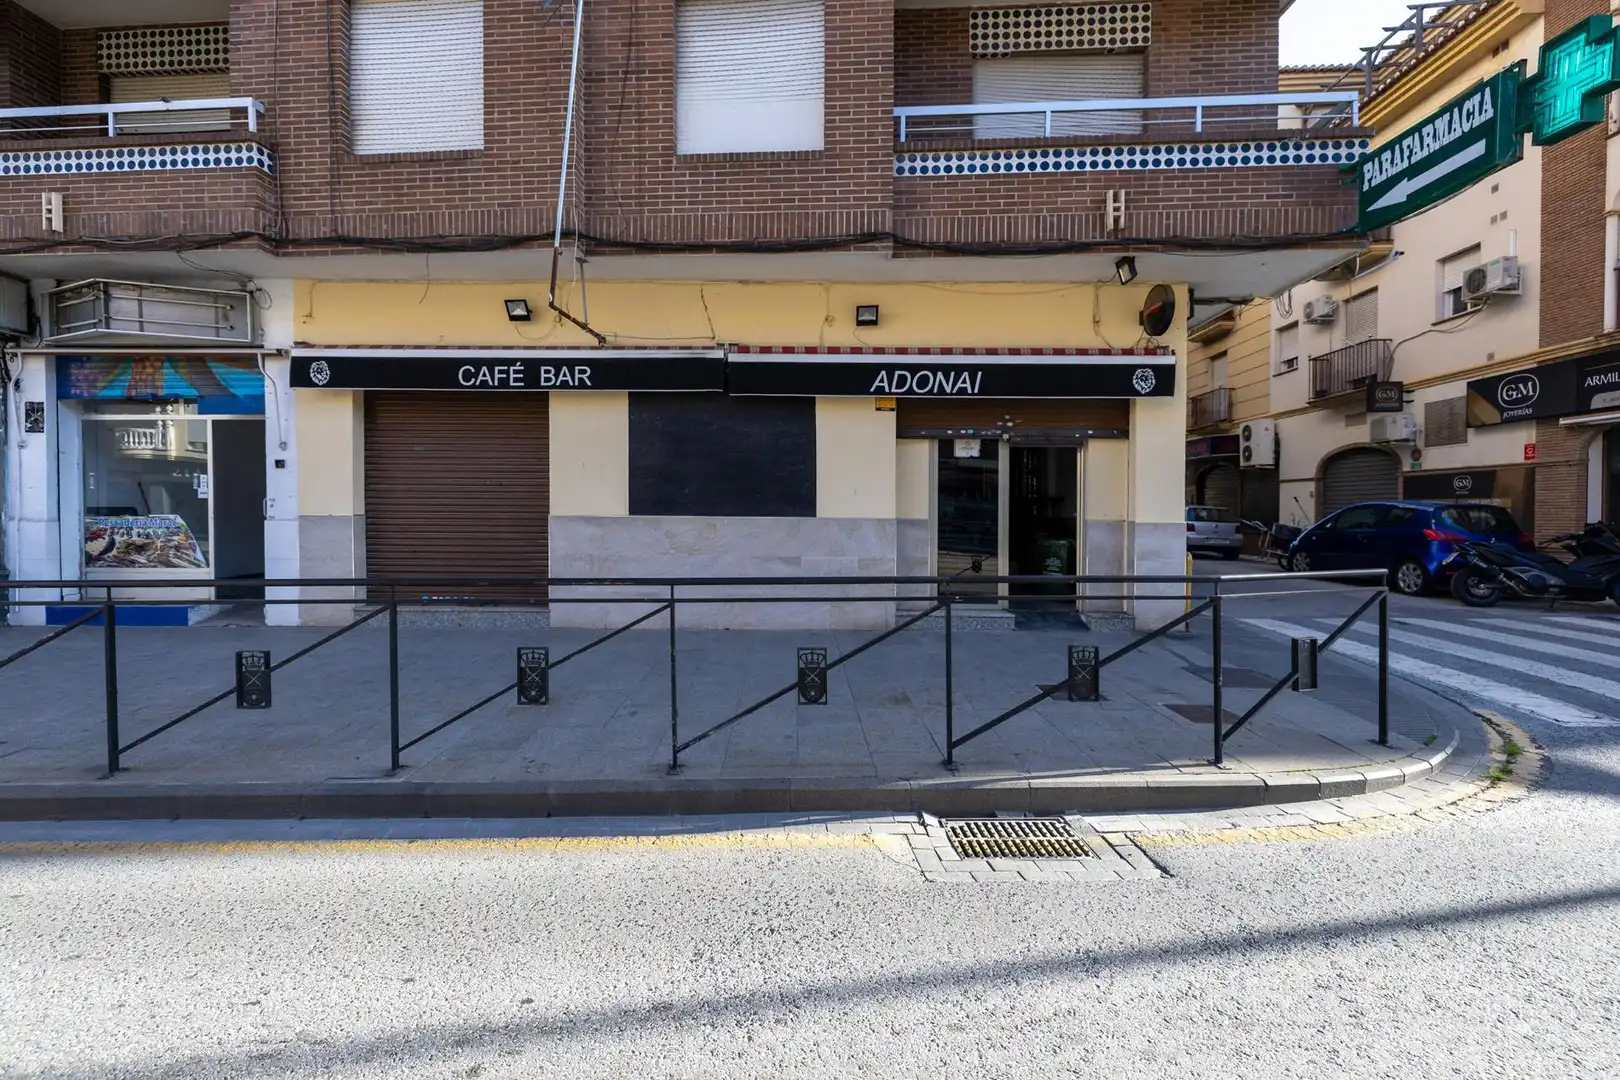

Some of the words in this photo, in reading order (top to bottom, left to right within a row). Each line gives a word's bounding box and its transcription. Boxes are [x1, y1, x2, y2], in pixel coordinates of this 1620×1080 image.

[1363, 87, 1494, 192] PARAFARMACIA
[458, 362, 525, 386] CAFÉ
[540, 366, 592, 386] BAR
[869, 370, 983, 394] ADONAI
[1502, 381, 1535, 401] GM
